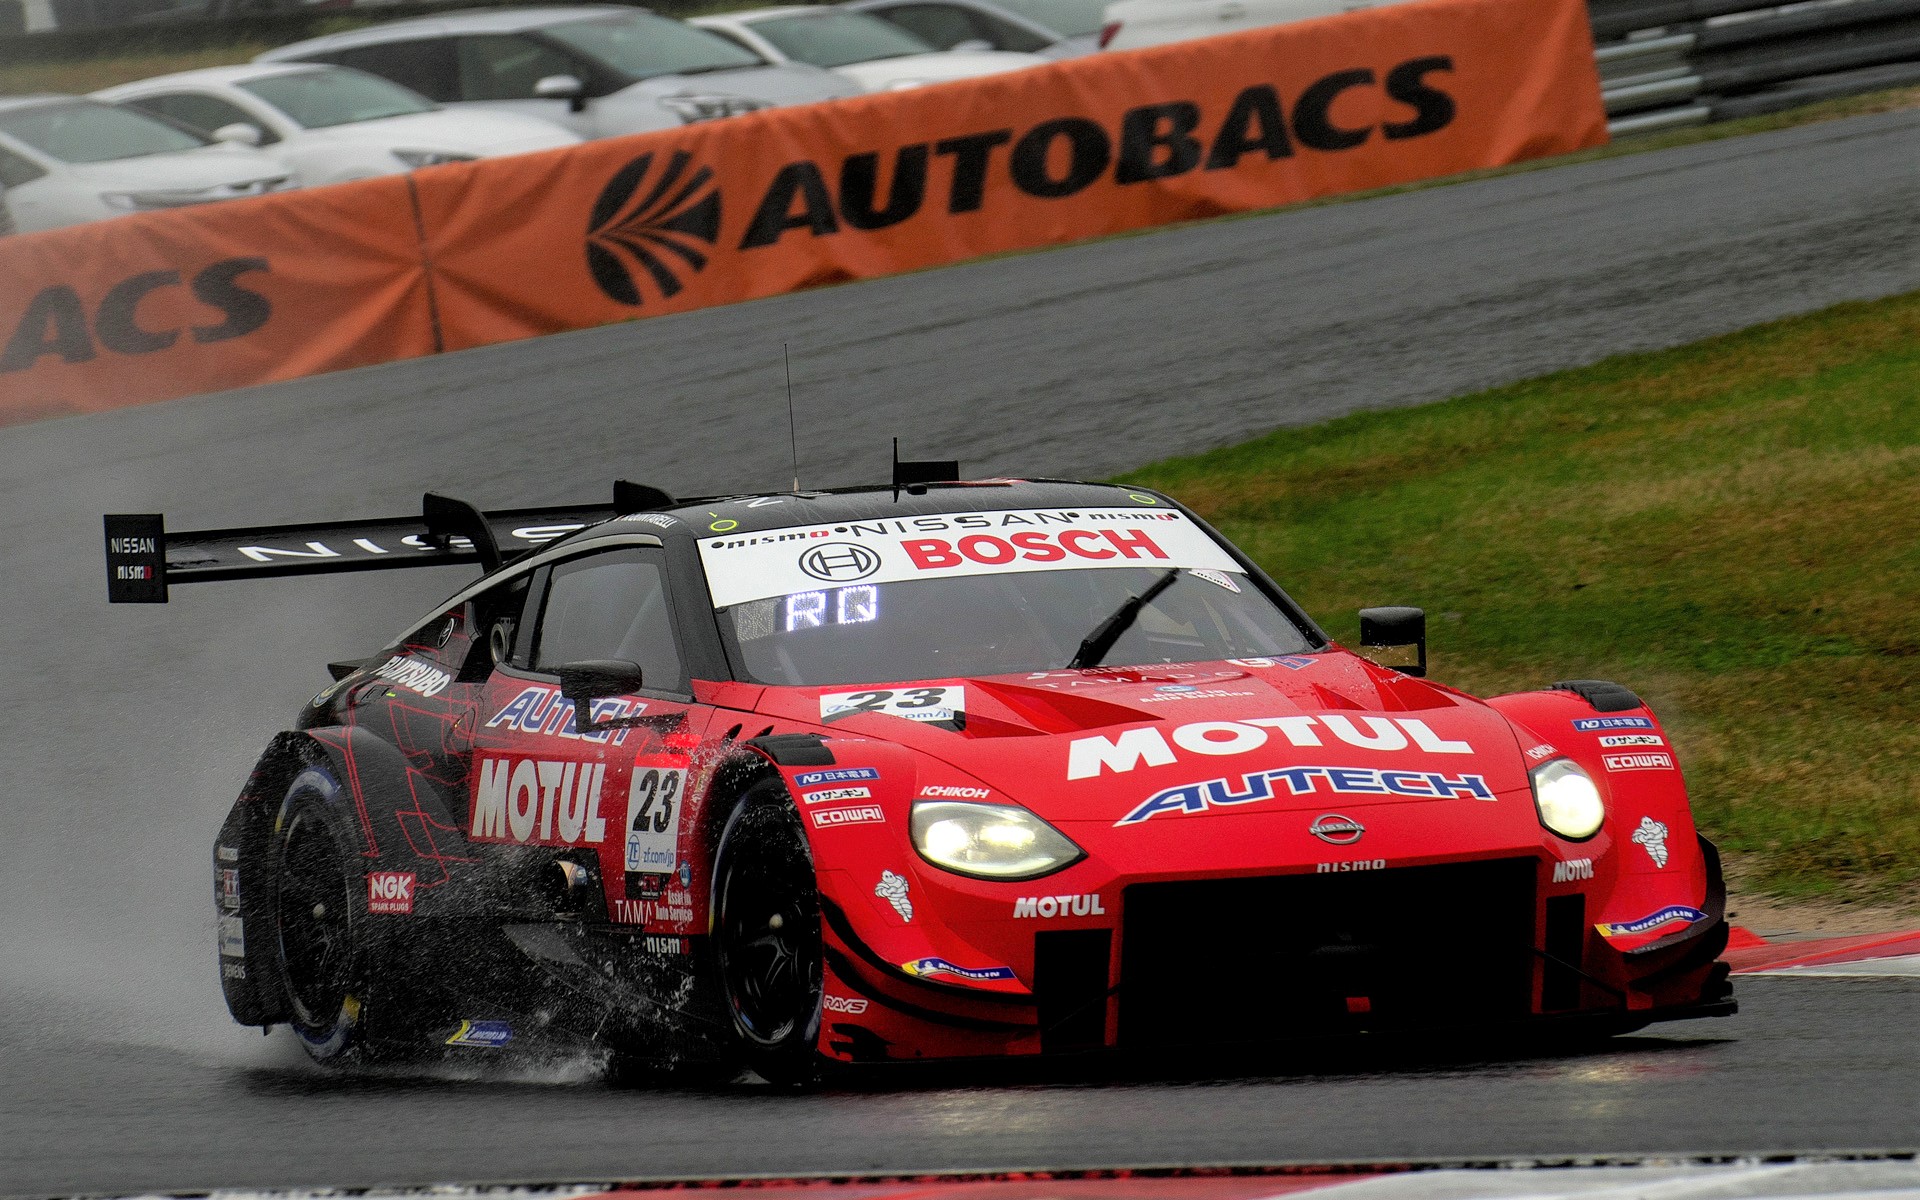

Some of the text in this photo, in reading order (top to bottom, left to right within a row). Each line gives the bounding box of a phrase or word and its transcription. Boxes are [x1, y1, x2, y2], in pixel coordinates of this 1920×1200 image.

[739, 55, 1457, 251] AUTOBACS
[728, 510, 1174, 550] nismo NISSAN nismo
[111, 537, 155, 554] NISSAN
[900, 529, 1171, 571] BOSCH
[117, 565, 153, 581] nismo
[370, 655, 451, 697] FUJITSUBO
[846, 687, 947, 711] 23
[1067, 715, 1475, 780] MOTUL
[1606, 755, 1671, 769] KOIWAI
[472, 758, 607, 844] MOTUL
[632, 769, 680, 834] 23
[920, 785, 991, 799] ICHIKOH
[1112, 766, 1498, 828] AUTECH
[814, 807, 882, 825] KOIWAI
[1310, 823, 1365, 833] NISSAN
[643, 847, 675, 868] zf.com/jp
[1316, 858, 1386, 874] nismo
[1552, 858, 1594, 883] MOTUL
[371, 875, 412, 900] NGK
[390, 903, 409, 911] PLUGS
[1012, 893, 1105, 918] MOTUL
[1630, 909, 1694, 932] MICHELIN
[646, 936, 690, 955] nismo
[938, 962, 1000, 978] MICHELIN
[823, 994, 869, 1015] RAYS
